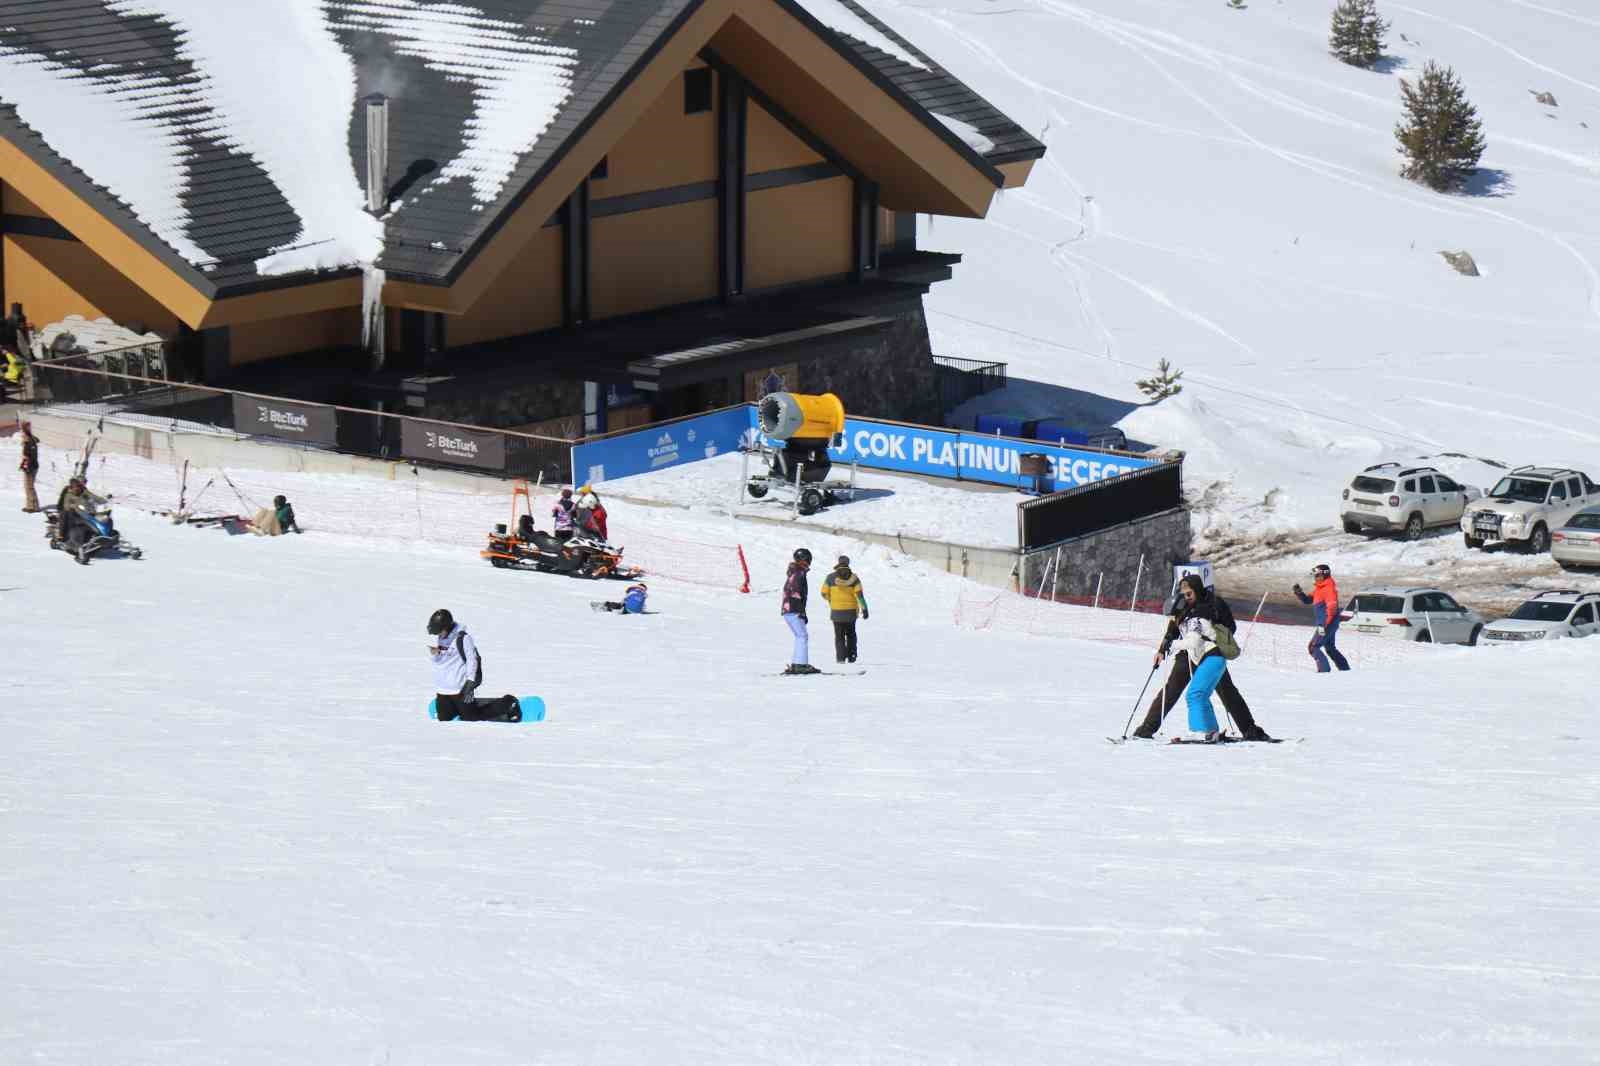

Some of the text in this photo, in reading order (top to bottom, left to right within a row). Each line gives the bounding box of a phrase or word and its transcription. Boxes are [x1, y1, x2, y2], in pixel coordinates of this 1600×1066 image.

[270, 410, 308, 426] BtcTurk
[438, 435, 479, 453] BtcTurk
[854, 430, 907, 460] ÇOK
